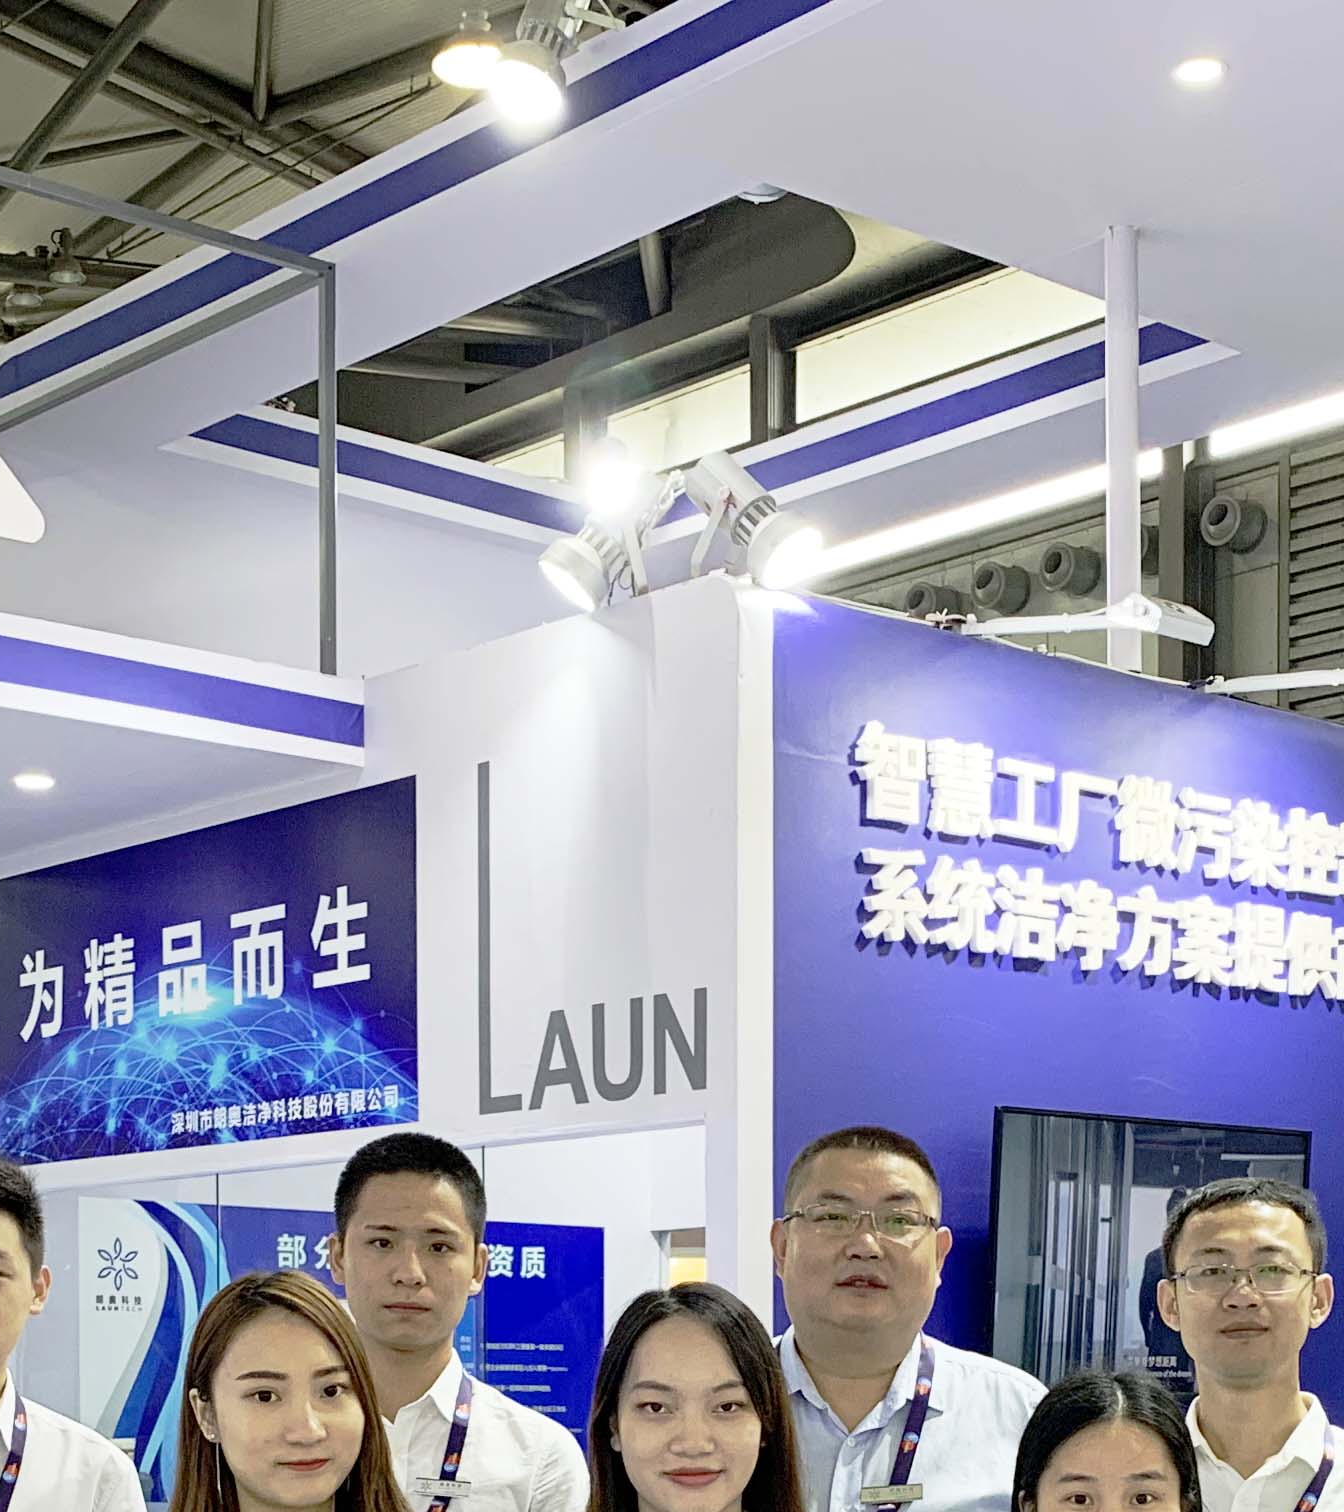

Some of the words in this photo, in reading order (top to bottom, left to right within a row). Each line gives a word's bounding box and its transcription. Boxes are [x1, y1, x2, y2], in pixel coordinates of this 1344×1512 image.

[19, 885, 371, 1043] 为精品而生
[478, 760, 707, 1115] LAUN
[171, 1085, 399, 1135] 深圳市朗奥洁净科技股份有限公司
